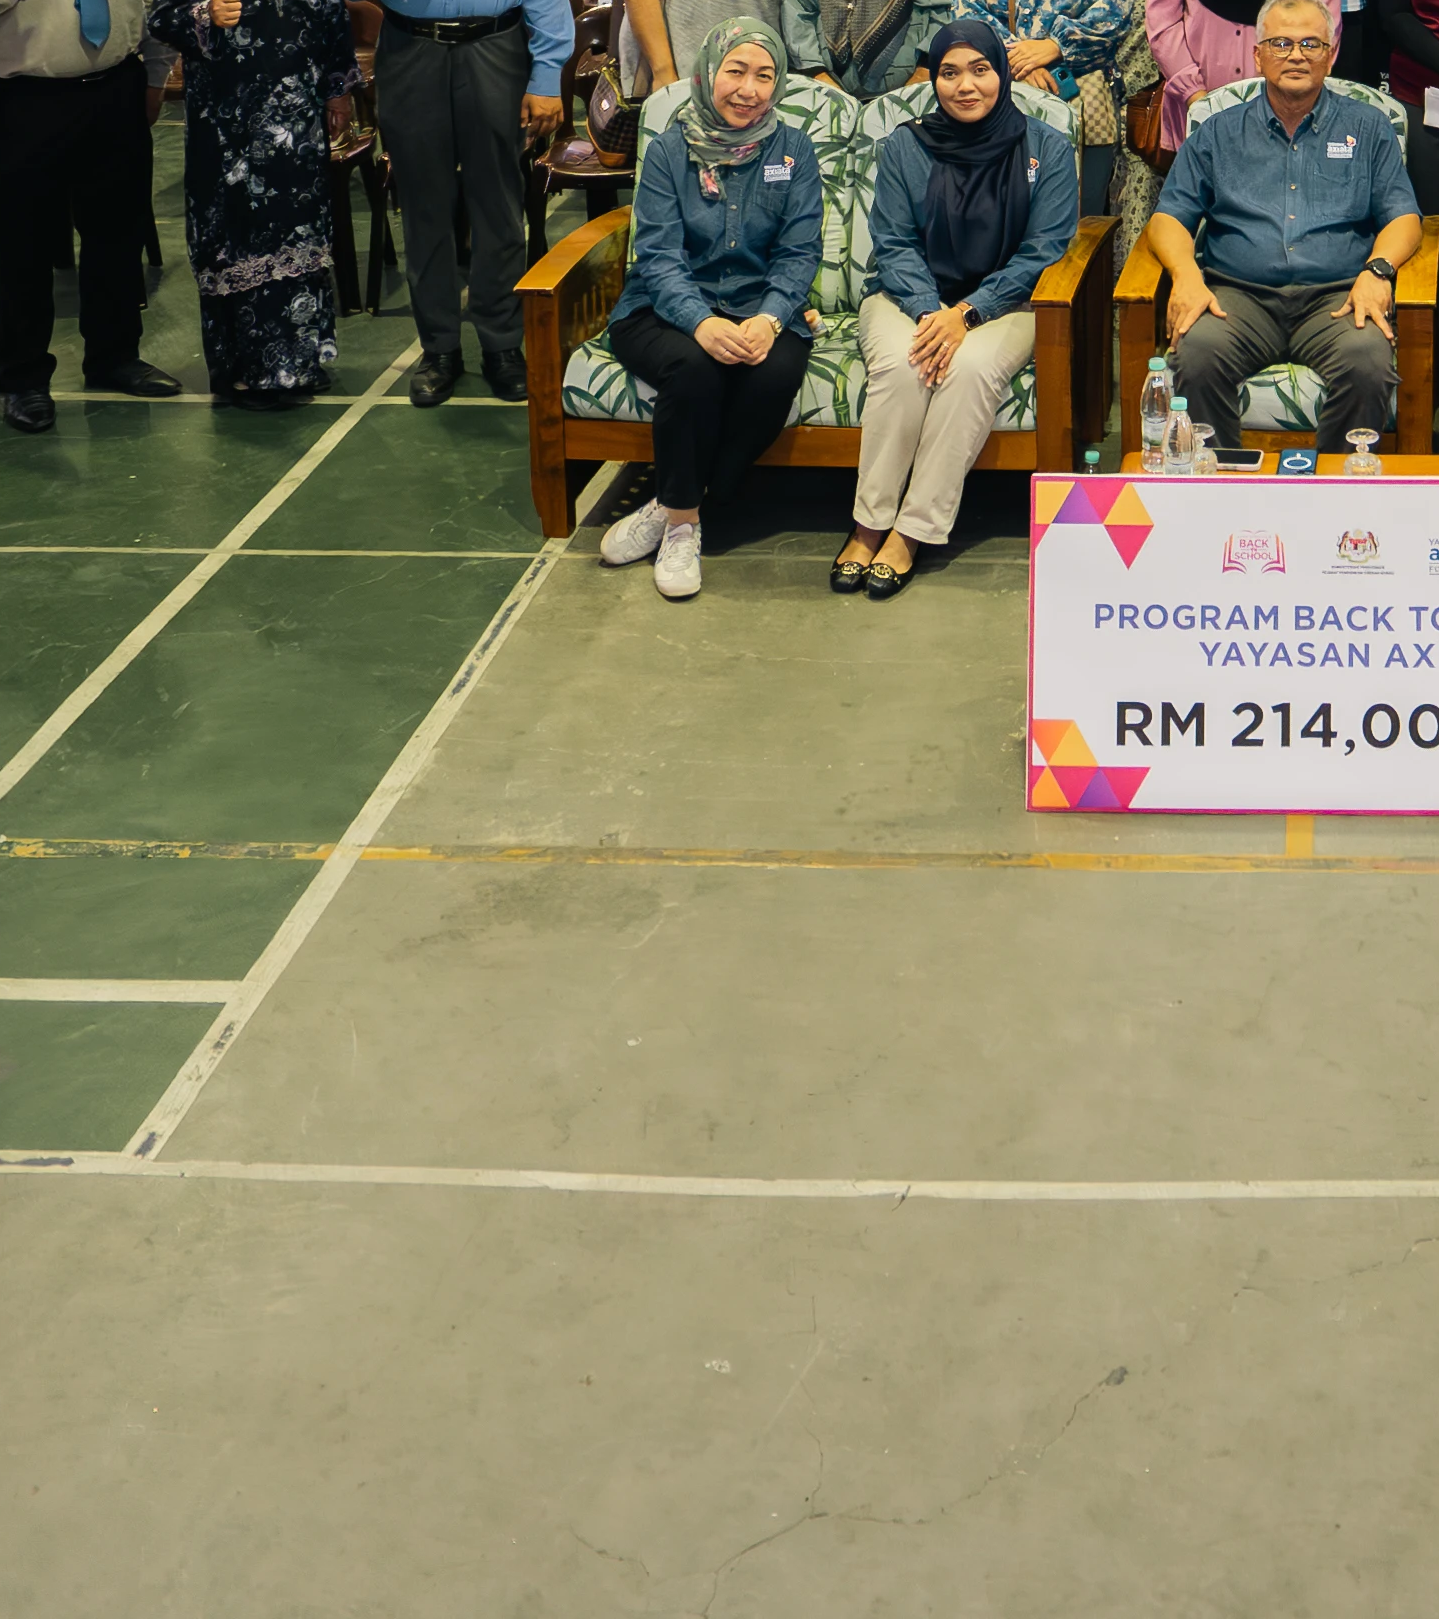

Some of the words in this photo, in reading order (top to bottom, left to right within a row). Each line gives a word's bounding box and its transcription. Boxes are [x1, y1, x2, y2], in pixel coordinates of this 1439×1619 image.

[1234, 552, 1273, 560] SCHOOL
[1239, 539, 1269, 548] BACK
[1094, 603, 1279, 631] PROGRAM
[1294, 605, 1395, 632] BACK
[1198, 641, 1370, 668] YAYASAN
[1116, 701, 1205, 746] RM
